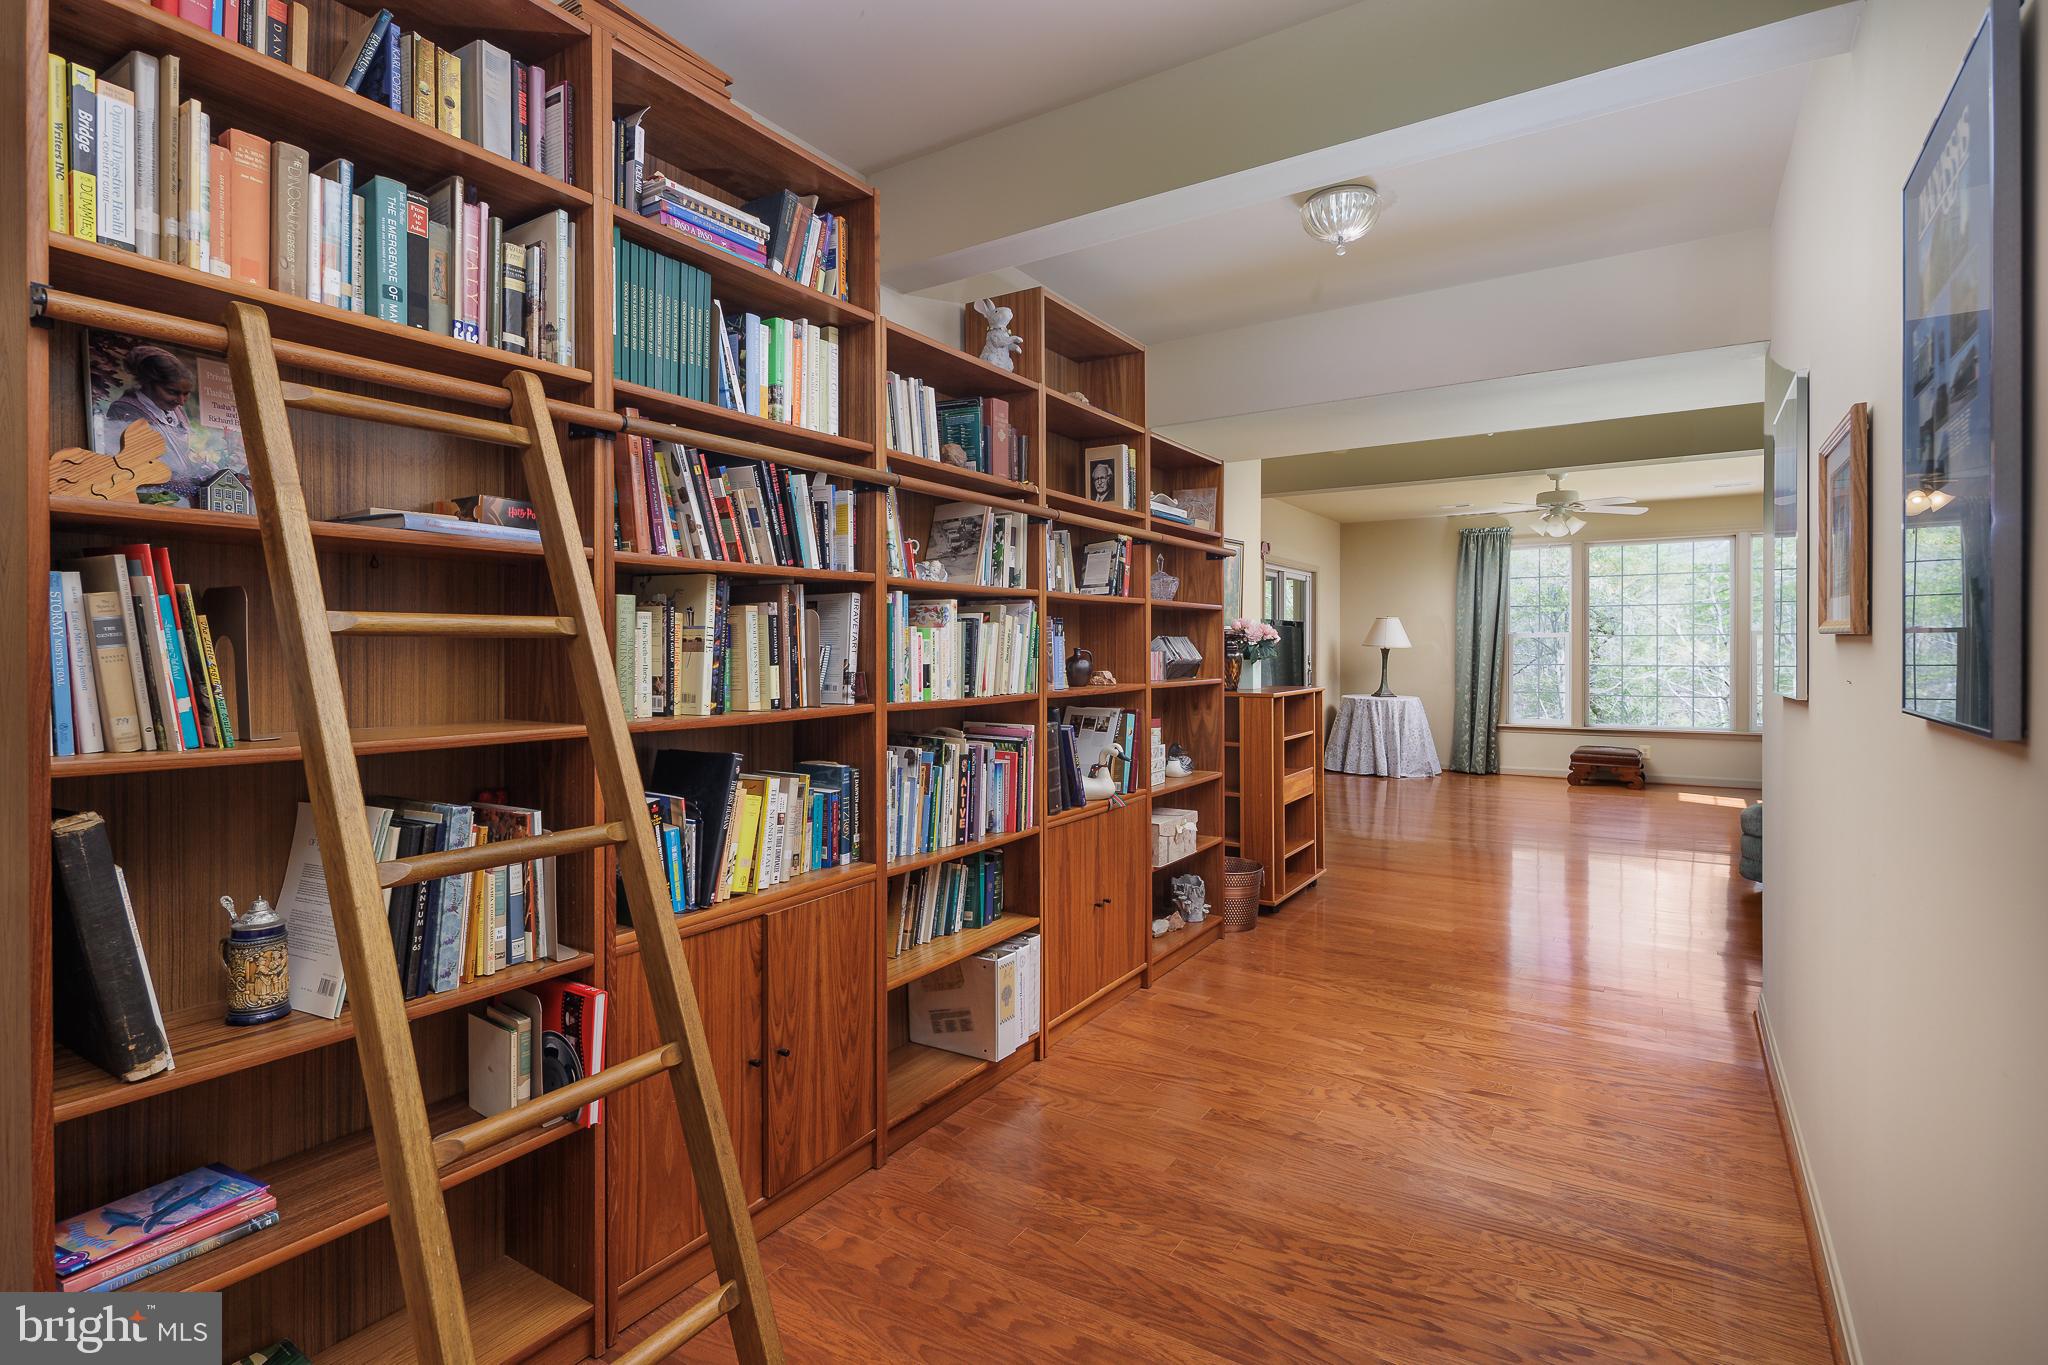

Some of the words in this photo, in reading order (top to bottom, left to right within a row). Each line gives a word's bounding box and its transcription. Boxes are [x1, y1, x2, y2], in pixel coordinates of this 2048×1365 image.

[356, 32, 381, 76] ERASMUS
[391, 47, 401, 71] KARL
[391, 71, 401, 105] POPPER
[75, 109, 93, 153] Bridge
[109, 104, 125, 149] Optimal
[54, 122, 65, 158] Writers
[55, 159, 65, 181] INC
[102, 140, 110, 177] COMPLETE
[108, 149, 125, 198] Digestive
[635, 163, 645, 194] ICELAND
[102, 179, 110, 203] GUIDE
[78, 182, 95, 239] DUMMIES
[110, 198, 125, 236] Health
[386, 195, 398, 215] THE
[410, 204, 426, 215] From
[412, 212, 424, 221] Ape
[410, 224, 426, 234] Adam
[674, 218, 690, 232] PASO
[696, 228, 713, 241] PASO
[286, 228, 297, 264] HERESIES
[387, 218, 399, 282] EMERGENCE
[466, 234, 479, 306] ITALY
[387, 285, 399, 301] OF
[211, 401, 231, 411] Tasha
[208, 414, 234, 425] Richard
[753, 470, 761, 487] WHAT
[508, 506, 527, 519] Harry
[51, 590, 64, 638] STORMY
[71, 610, 80, 624] Life
[199, 621, 209, 635] The
[619, 616, 628, 661] FORGOTTEN
[705, 625, 714, 652] LIFE
[54, 638, 65, 666] MISTY'S
[74, 647, 85, 664] Mary
[203, 636, 214, 660] Little
[57, 667, 66, 687] FOAL
[76, 664, 88, 692] Jemison
[220, 712, 233, 734] Could
[729, 779, 738, 791] THE
[726, 790, 736, 805] FIRST
[959, 776, 968, 829] ALIVE
[722, 805, 734, 830] HUMANS
[842, 796, 850, 841] FITZROY
[775, 835, 783, 848] THIRD
[776, 826, 784, 834] THE
[764, 809, 776, 876] NEANDERTALS
[416, 880, 428, 927] UANTUM
[412, 943, 421, 951] 65
[413, 935, 423, 943] 19
[100, 1267, 116, 1280] The
[158, 1238, 189, 1256] Treasury
[107, 1277, 128, 1291] THE
[133, 1264, 163, 1281] BOOK
[165, 1256, 182, 1268] OF
[182, 1239, 223, 1260] PIRATES
